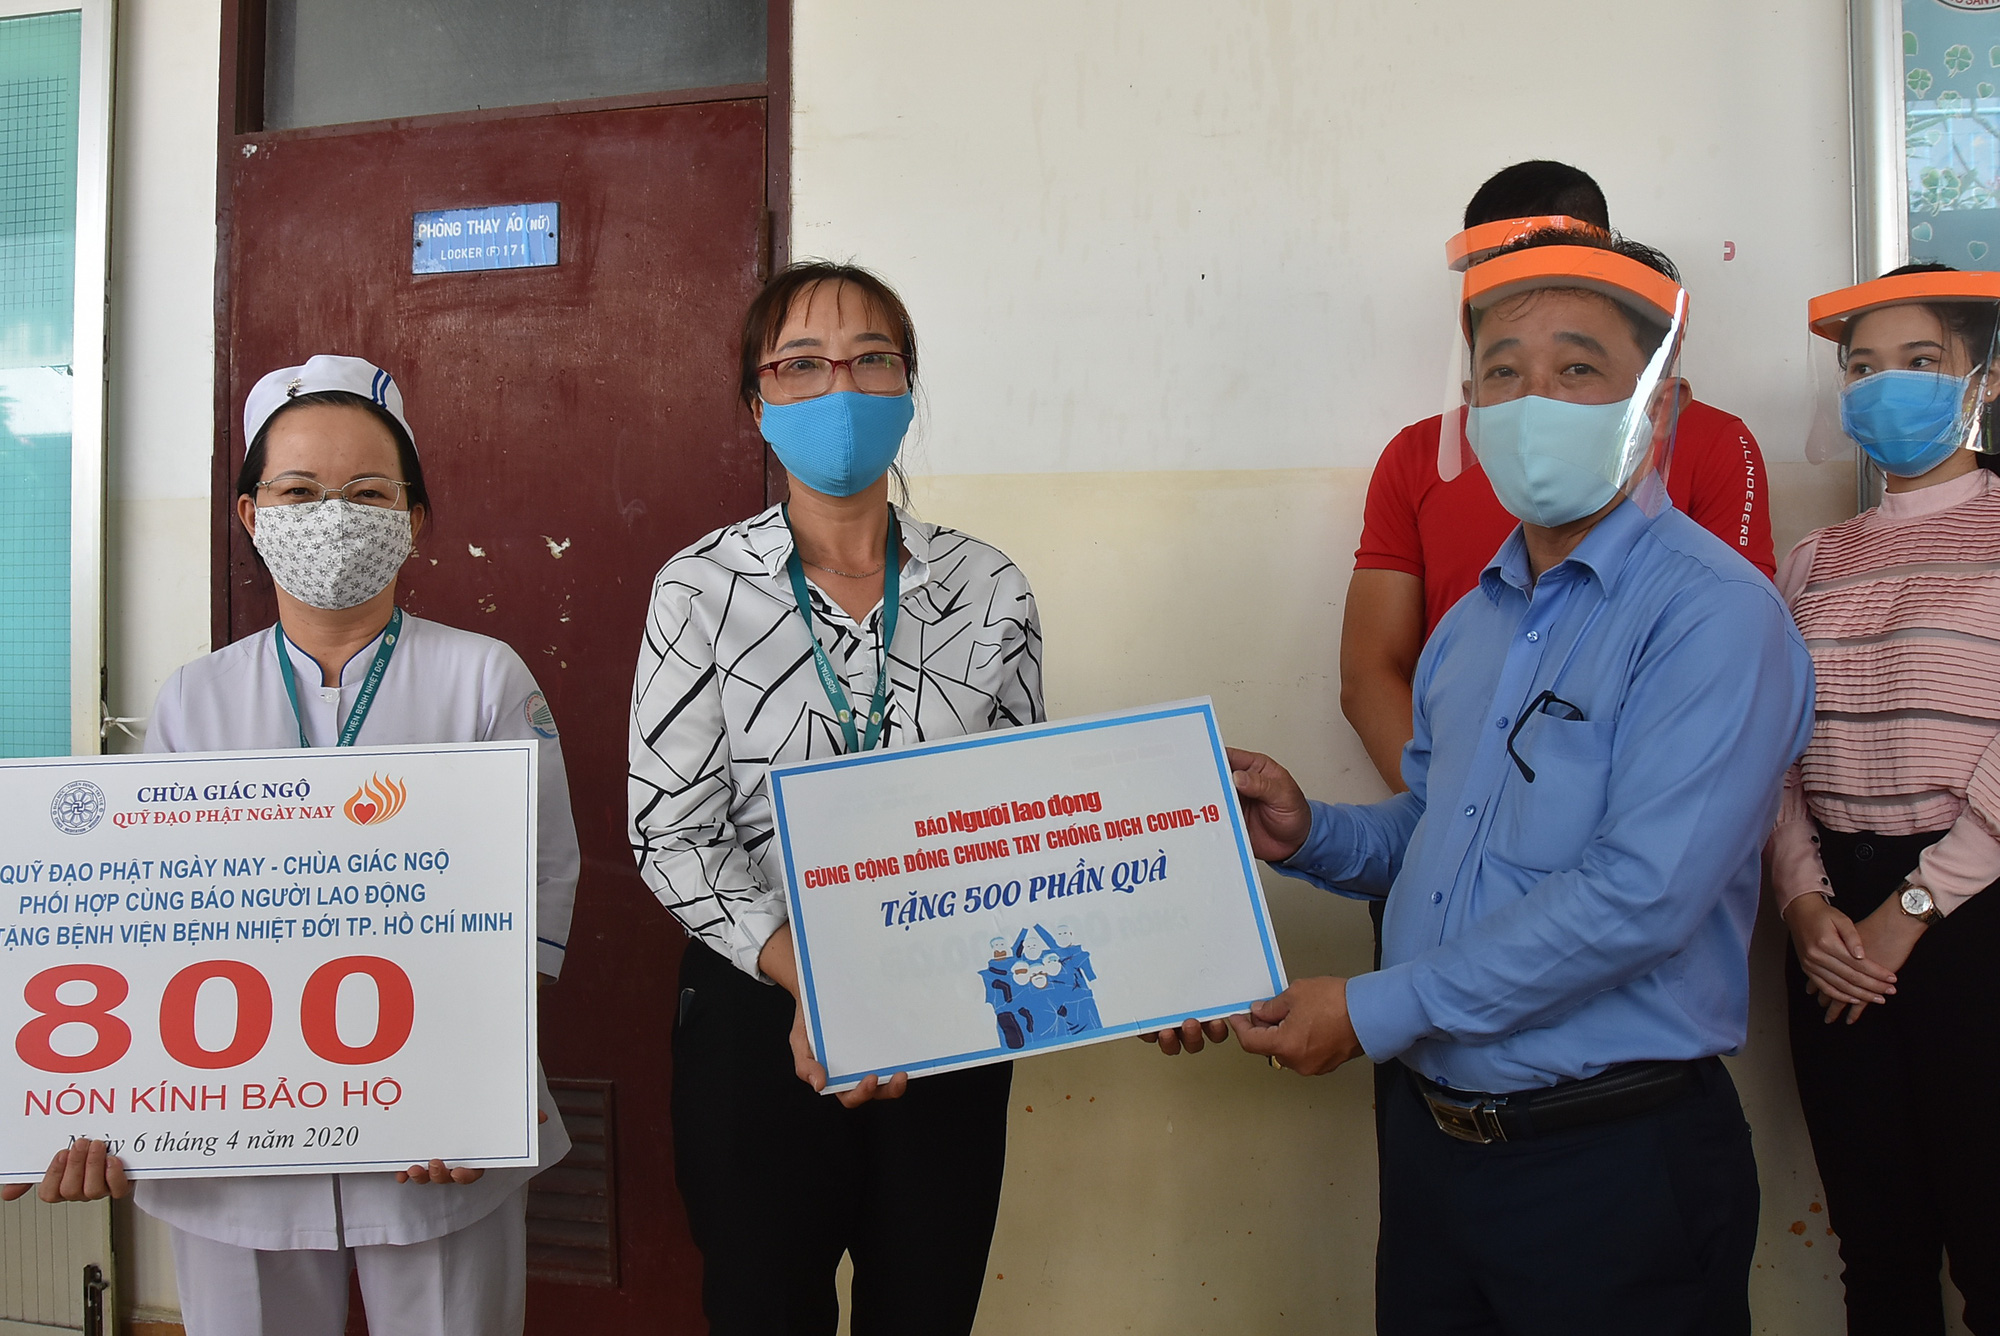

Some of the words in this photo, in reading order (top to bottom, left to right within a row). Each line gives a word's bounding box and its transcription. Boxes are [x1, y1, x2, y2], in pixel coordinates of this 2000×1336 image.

[418, 218, 462, 238] PHÒNG
[466, 218, 501, 235] THAY
[506, 212, 523, 233] ÁO
[440, 247, 482, 260] LOCKER
[1739, 436, 1754, 546] J.LINDEBERG
[821, 664, 838, 694] HOSPITAL
[137, 782, 198, 803] CHÙA
[203, 781, 257, 800] GIÁC
[261, 778, 311, 802] NGỘ
[112, 806, 151, 829] QUỸ
[154, 810, 191, 828] ĐẠO
[196, 806, 243, 825] PHẬT
[247, 805, 296, 821] NGÀY
[299, 805, 335, 819] NAY
[914, 815, 949, 838] BÁO
[947, 802, 1011, 834] Người
[1011, 800, 1047, 823] lao
[1047, 791, 1102, 817] động
[804, 865, 850, 889] CÙNG
[854, 856, 900, 882] CỘNG
[903, 847, 950, 873] ĐỒNG
[953, 838, 1010, 865] CHUNG
[1012, 833, 1041, 855] TAY
[1046, 822, 1102, 850] CHỐNG
[1103, 816, 1144, 841] DỊCH
[1146, 804, 1220, 833] COVID-19
[0, 860, 44, 885] QUỸ
[48, 862, 94, 887] ĐẠO
[100, 858, 154, 885] PHẬT
[159, 854, 218, 879] NGÀY
[223, 857, 266, 877] NAY
[283, 850, 341, 875] CHÙA
[347, 848, 398, 873] GIÁC
[404, 848, 450, 874] NGỘ
[19, 890, 69, 915] PHỐI
[74, 893, 120, 917] HỢP
[125, 887, 184, 912] CÙNG
[190, 885, 235, 910] BÁO
[241, 882, 311, 908] NGƯỜI
[317, 885, 359, 906] LAO
[365, 881, 426, 908] ĐỘNG
[880, 890, 956, 931] TẶNG
[963, 880, 1021, 913] 500
[1028, 857, 1105, 903] PHẦN
[1111, 848, 1168, 894] QUÀ
[56, 922, 114, 950] BỆNH
[120, 920, 167, 948] VIỆN
[173, 919, 230, 946] BỆNH
[236, 916, 297, 943] NHIỆT
[302, 913, 340, 938] ĐỚI
[346, 917, 377, 937] TP.
[384, 911, 414, 936] HỒ
[420, 909, 455, 934] CHÍ
[461, 912, 513, 932] MINH
[15, 955, 415, 1074] 800
[24, 1083, 116, 1116] NÓN
[130, 1080, 227, 1114] KÍNH
[242, 1076, 328, 1110] BẢO
[342, 1076, 403, 1111] HỘ
[133, 1132, 147, 1153] 6
[154, 1129, 217, 1157] tháng
[226, 1129, 239, 1151] 4
[246, 1130, 295, 1150] năm
[302, 1125, 360, 1149] 2020
